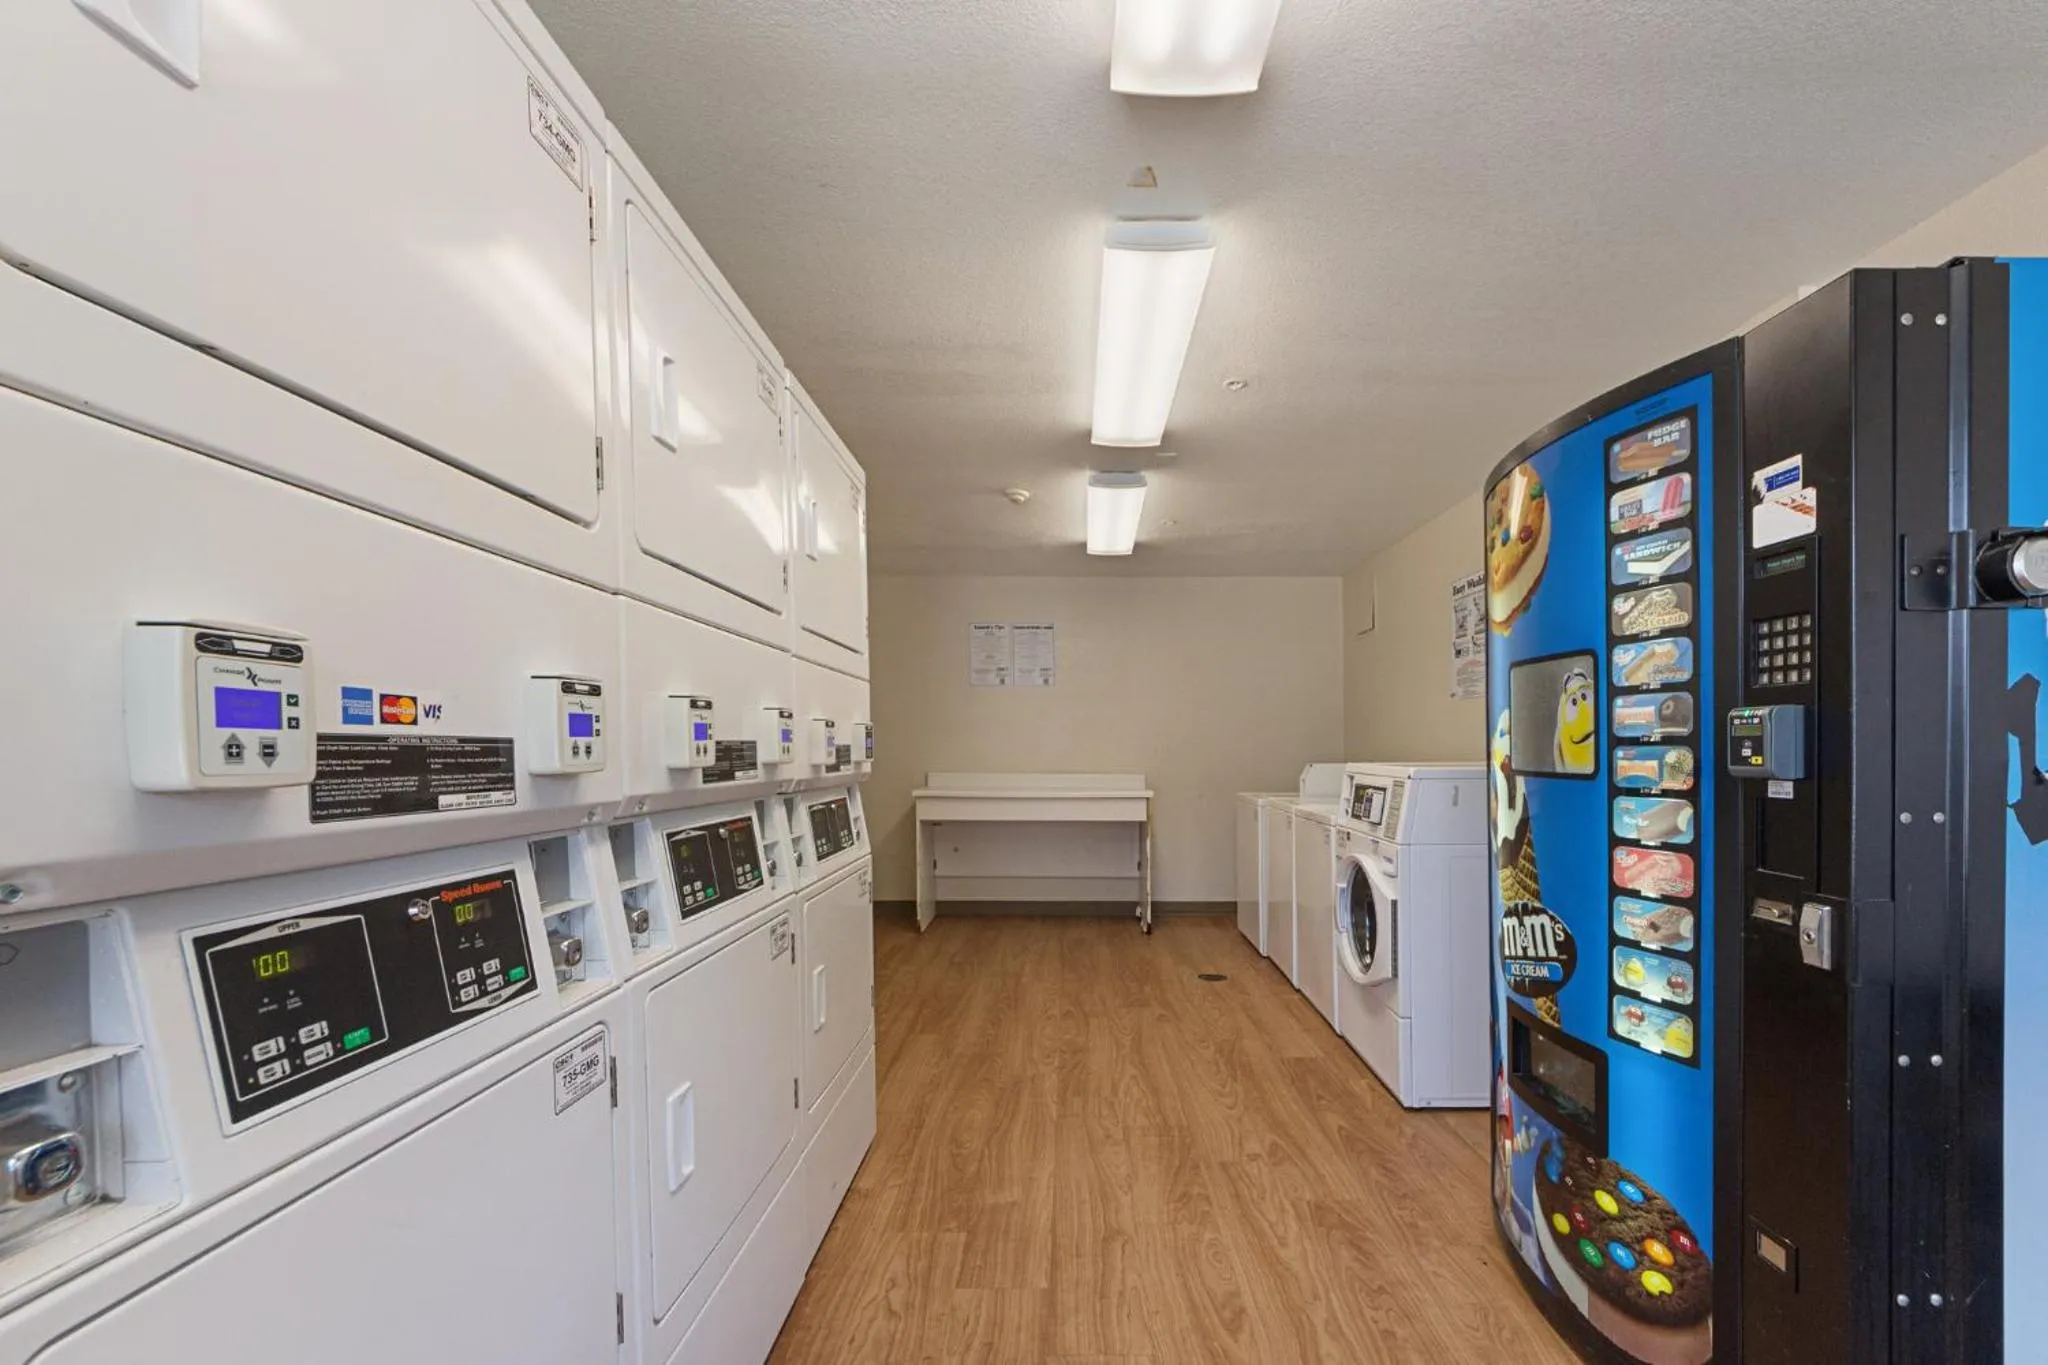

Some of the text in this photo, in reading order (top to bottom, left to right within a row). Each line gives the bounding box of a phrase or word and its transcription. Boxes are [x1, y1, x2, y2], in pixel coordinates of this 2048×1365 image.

[1648, 418, 1687, 442] FUDGE
[1653, 431, 1680, 448] BAR
[1623, 541, 1681, 561] SANDWICH
[562, 1055, 600, 1087] 735-GMG
